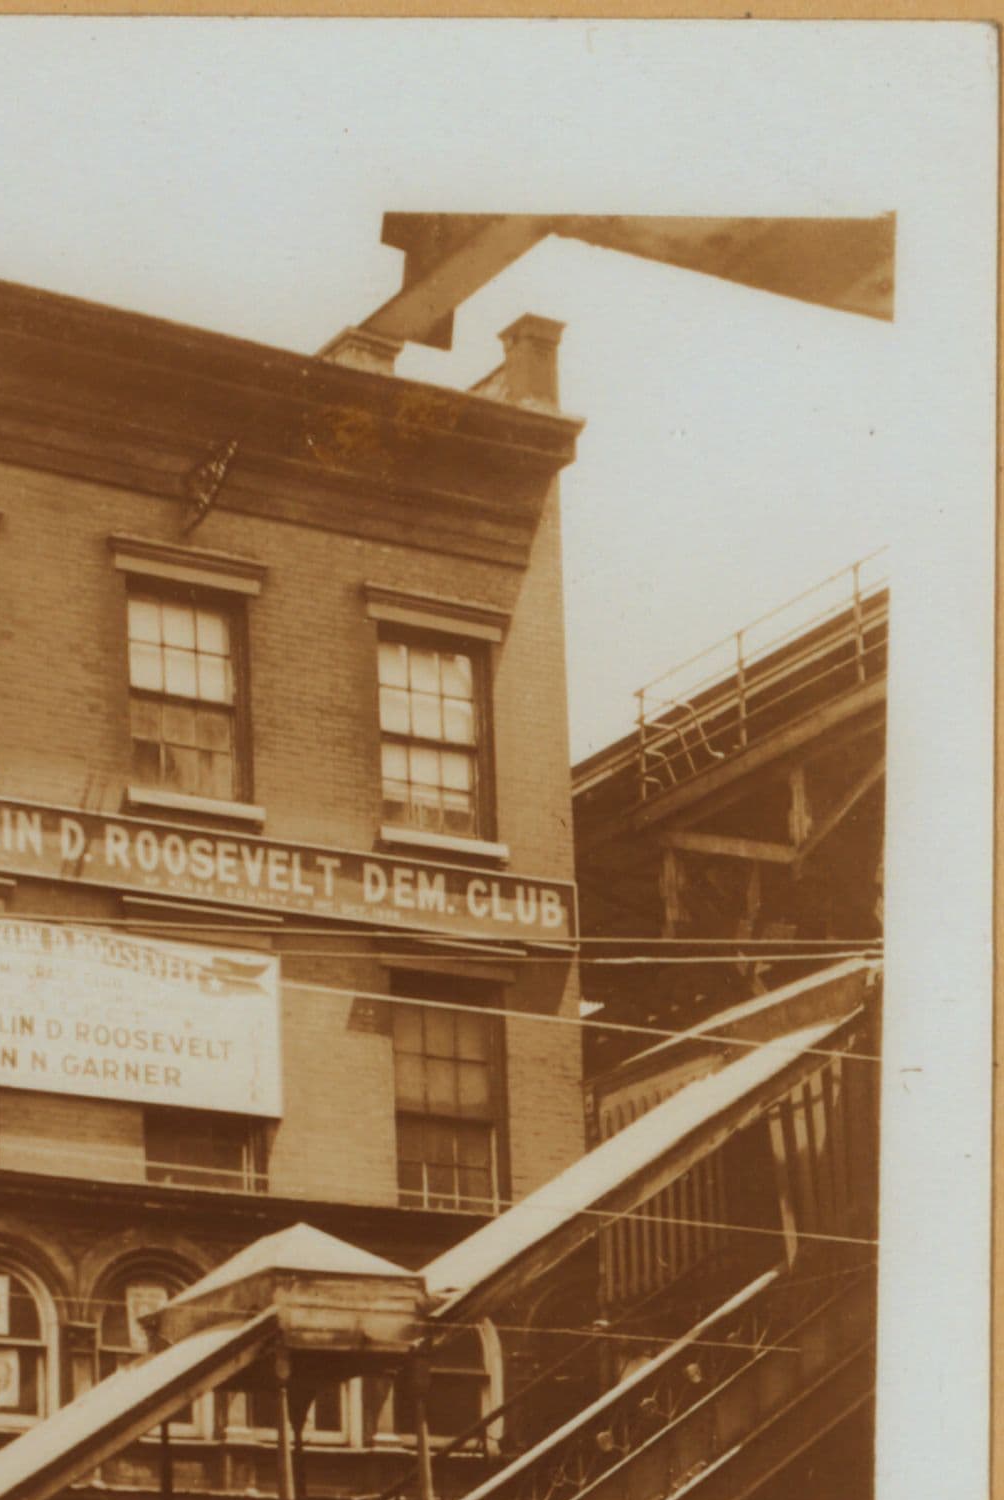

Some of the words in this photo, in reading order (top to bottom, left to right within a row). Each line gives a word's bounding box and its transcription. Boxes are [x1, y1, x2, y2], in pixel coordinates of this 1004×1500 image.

[60, 816, 92, 862] D.
[104, 823, 341, 897] ROOSEVELT
[363, 862, 455, 915] DEM.
[465, 878, 564, 928] CLUB
[46, 1018, 63, 1040] D
[75, 1021, 233, 1061] ROOSEVELT
[61, 1054, 182, 1088] GARNER
